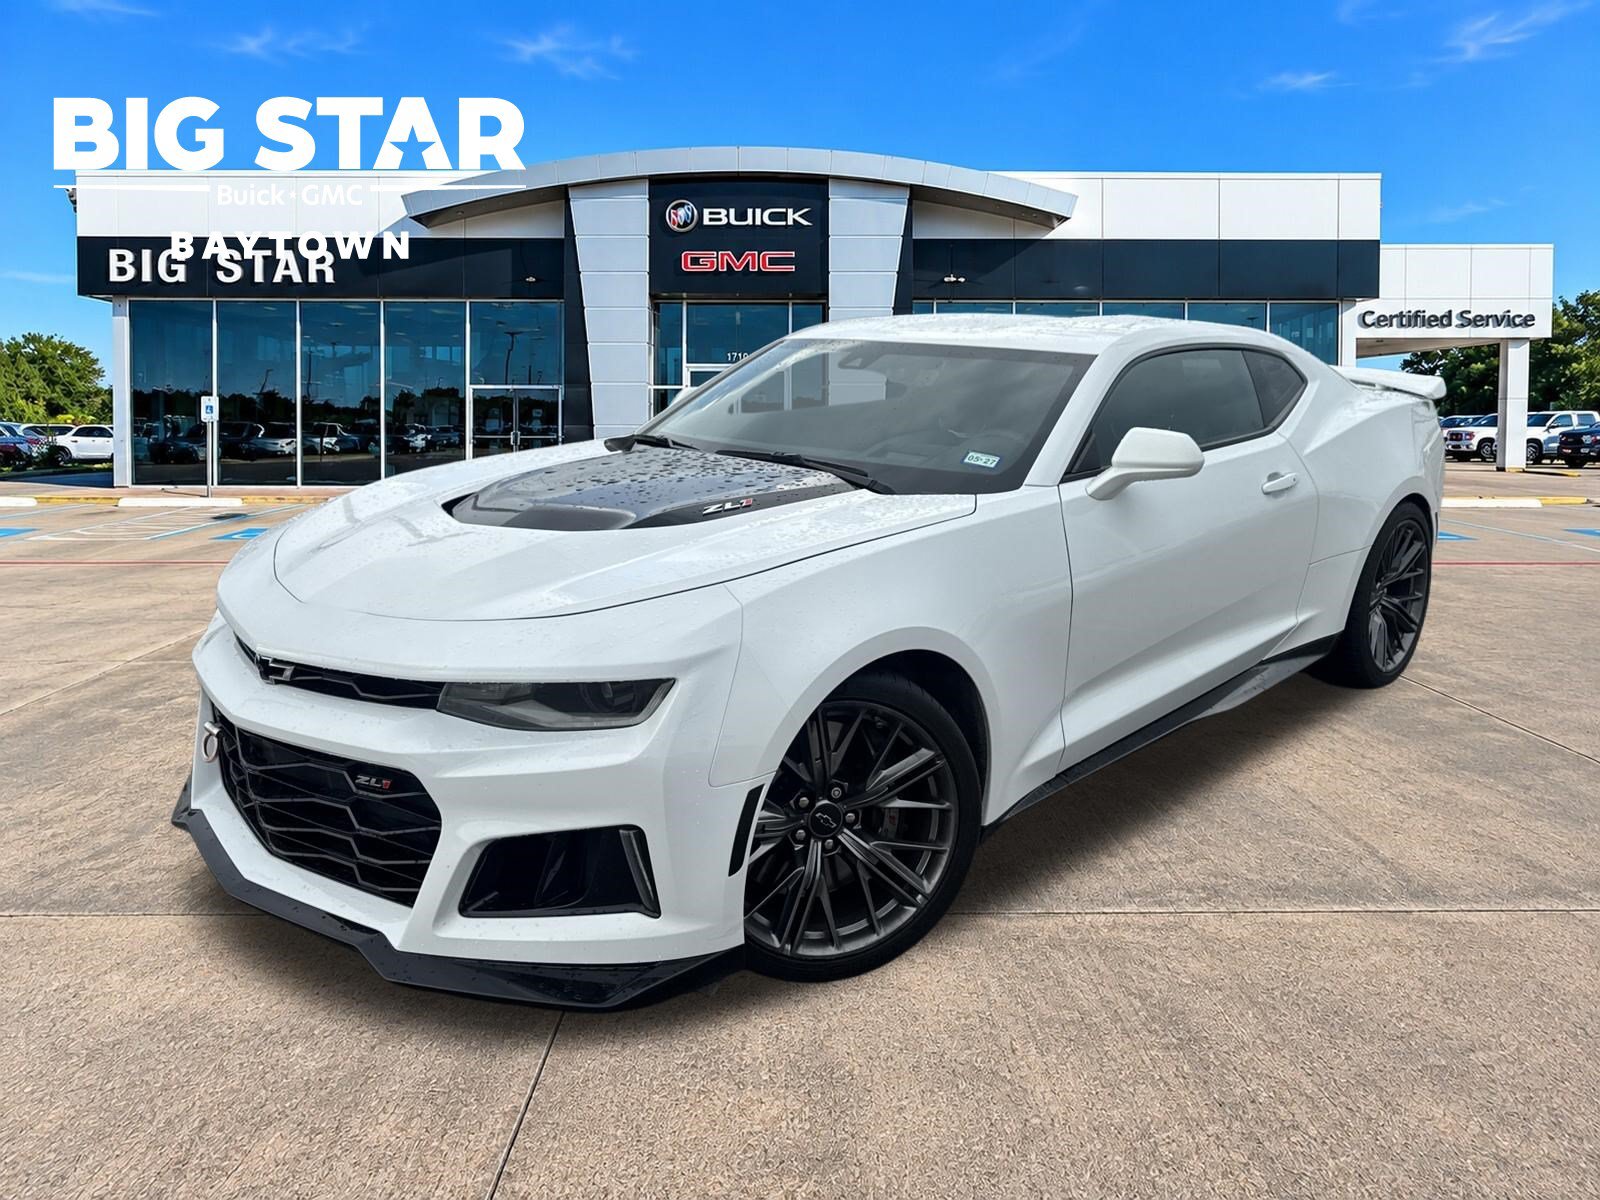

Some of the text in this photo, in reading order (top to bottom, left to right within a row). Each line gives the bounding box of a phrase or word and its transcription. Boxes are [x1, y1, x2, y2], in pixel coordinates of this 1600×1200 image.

[703, 207, 813, 226] BUICK
[108, 248, 336, 283] BIG STAR
[681, 250, 796, 272] GMC
[1360, 310, 1536, 328] Certified Service
[702, 498, 753, 515] ZL1
[355, 775, 392, 790] ZL1
